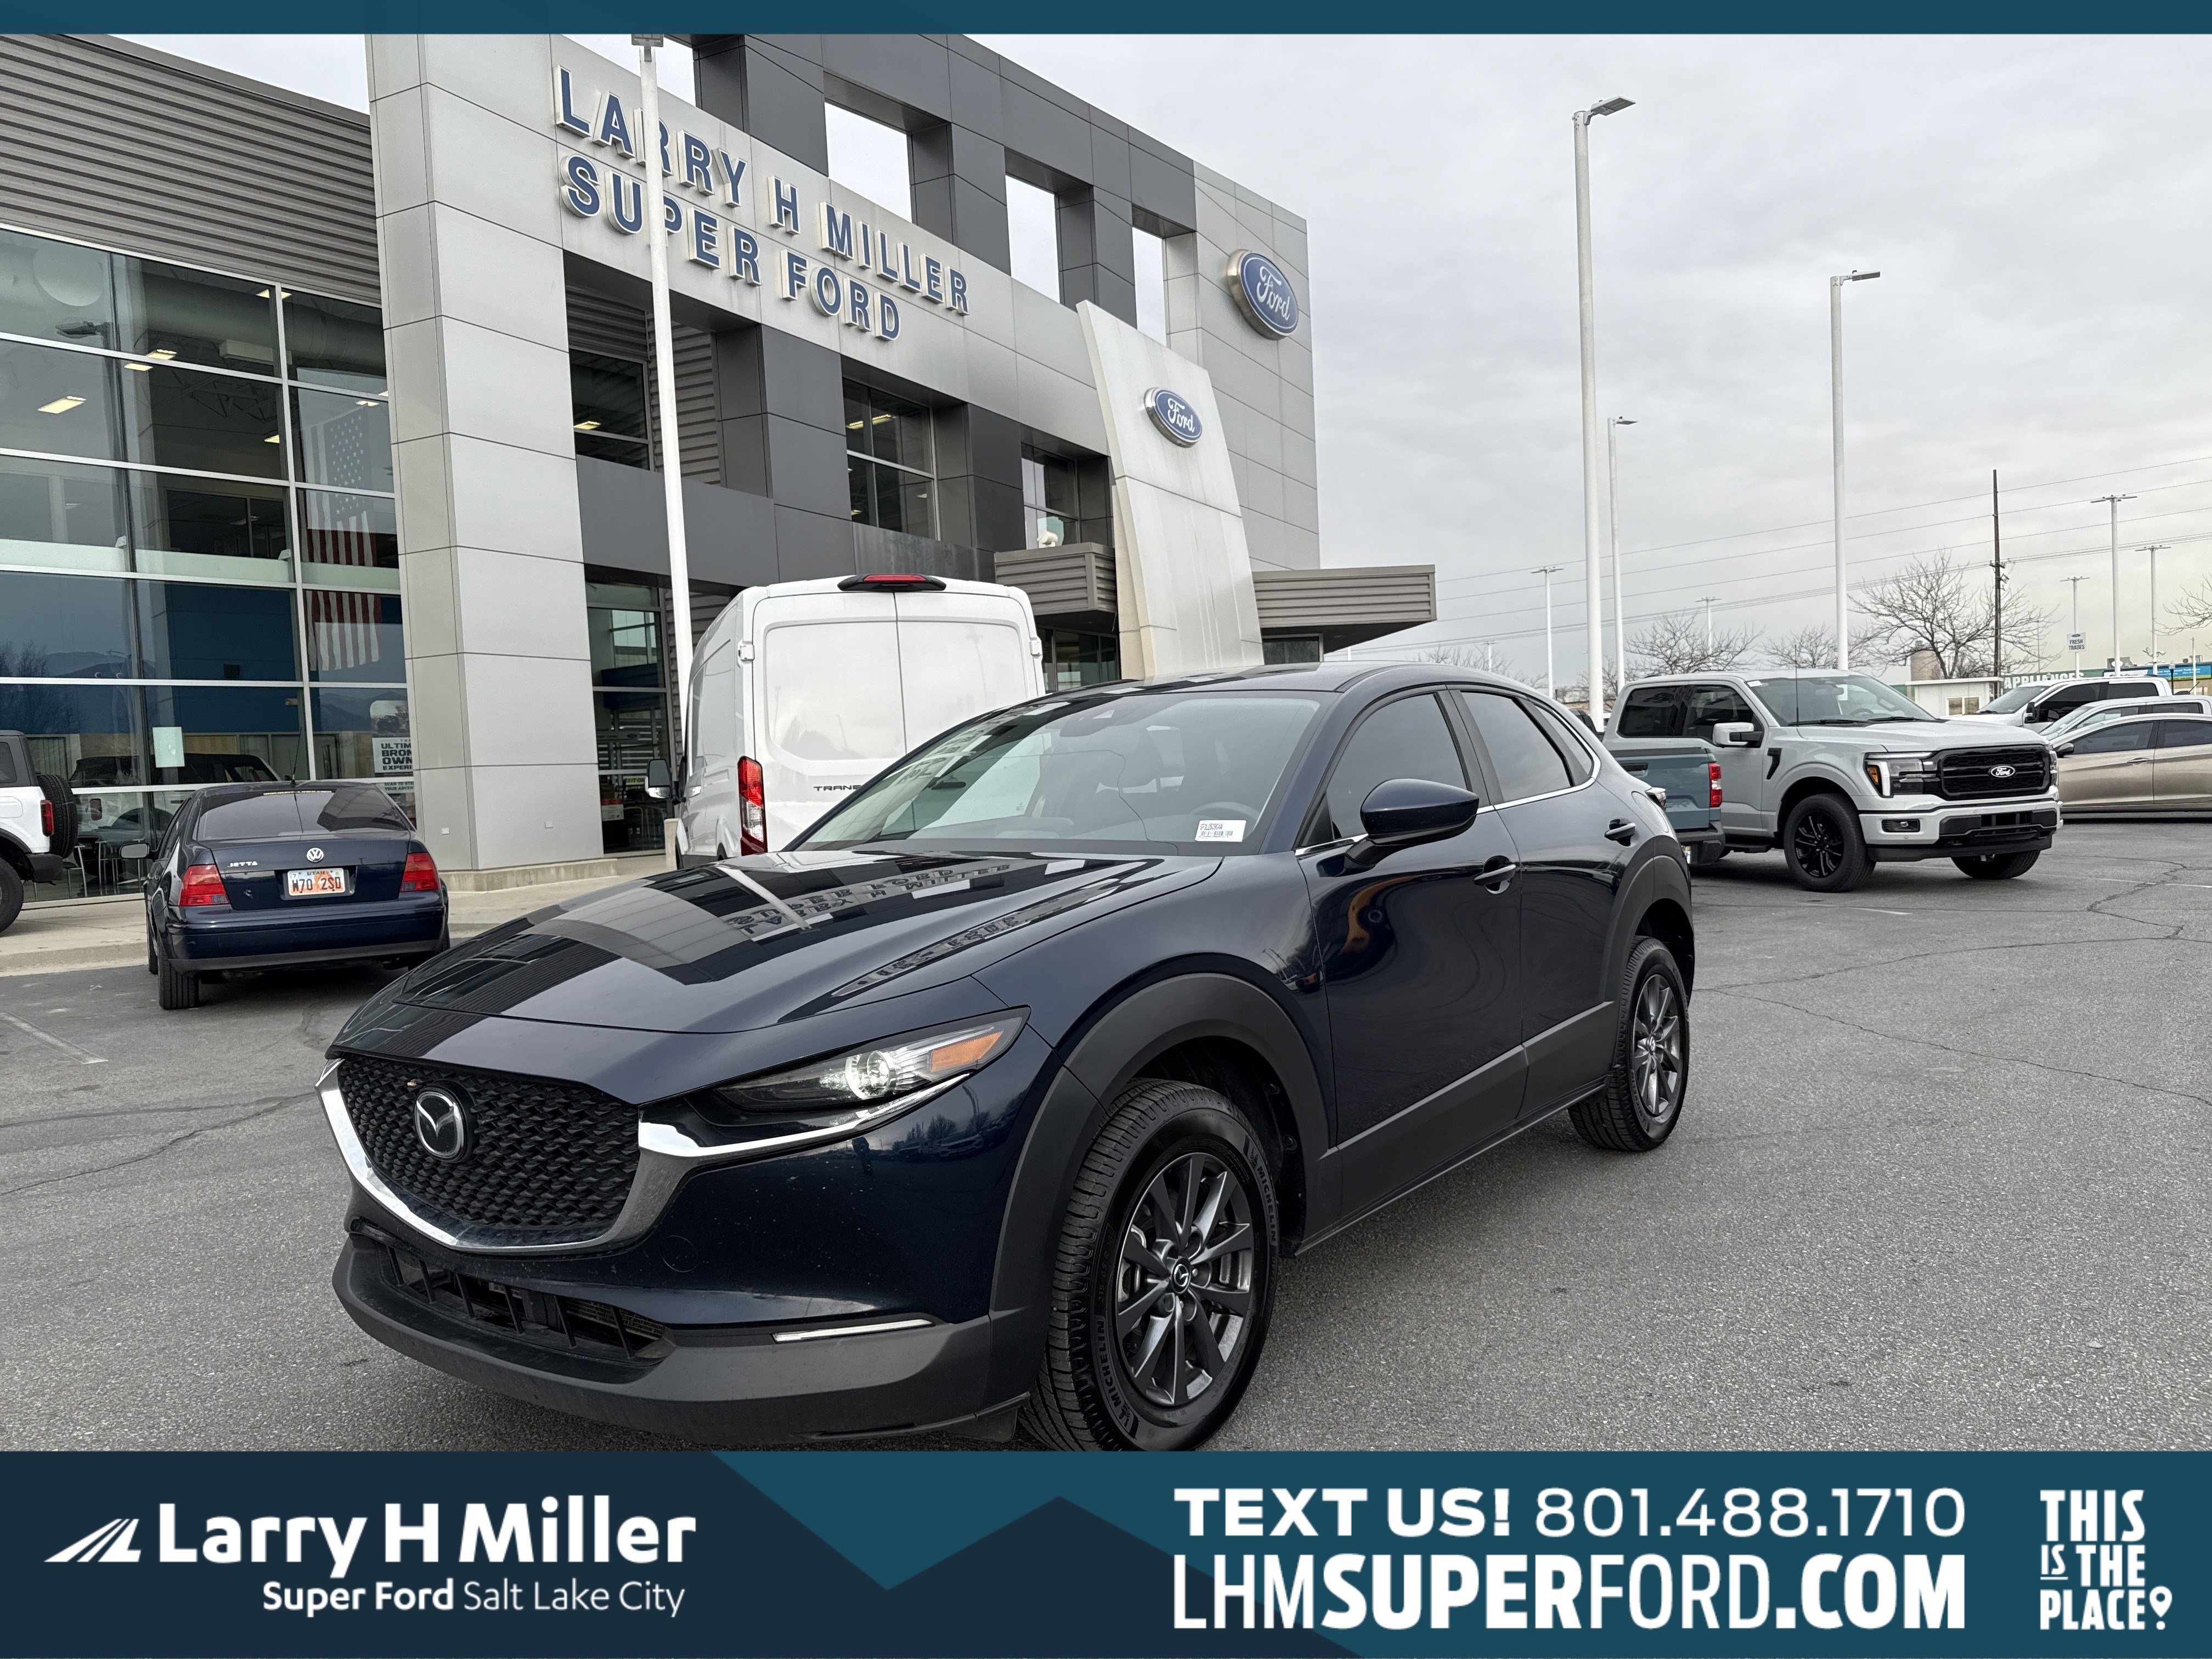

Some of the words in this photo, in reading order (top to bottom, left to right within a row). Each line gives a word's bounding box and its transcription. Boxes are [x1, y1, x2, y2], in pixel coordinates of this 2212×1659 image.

[556, 65, 747, 207] LARRY
[768, 176, 800, 235] H
[820, 202, 969, 315] MILLER
[561, 154, 761, 285] SUPER
[781, 249, 900, 340] FORD
[1256, 266, 1290, 321] Ford
[1167, 397, 1195, 433] Ford
[1995, 768, 2011, 776] Ford
[1257, 1166, 1276, 1242] MICHELIN
[1098, 1321, 1122, 1408] MICHELIN
